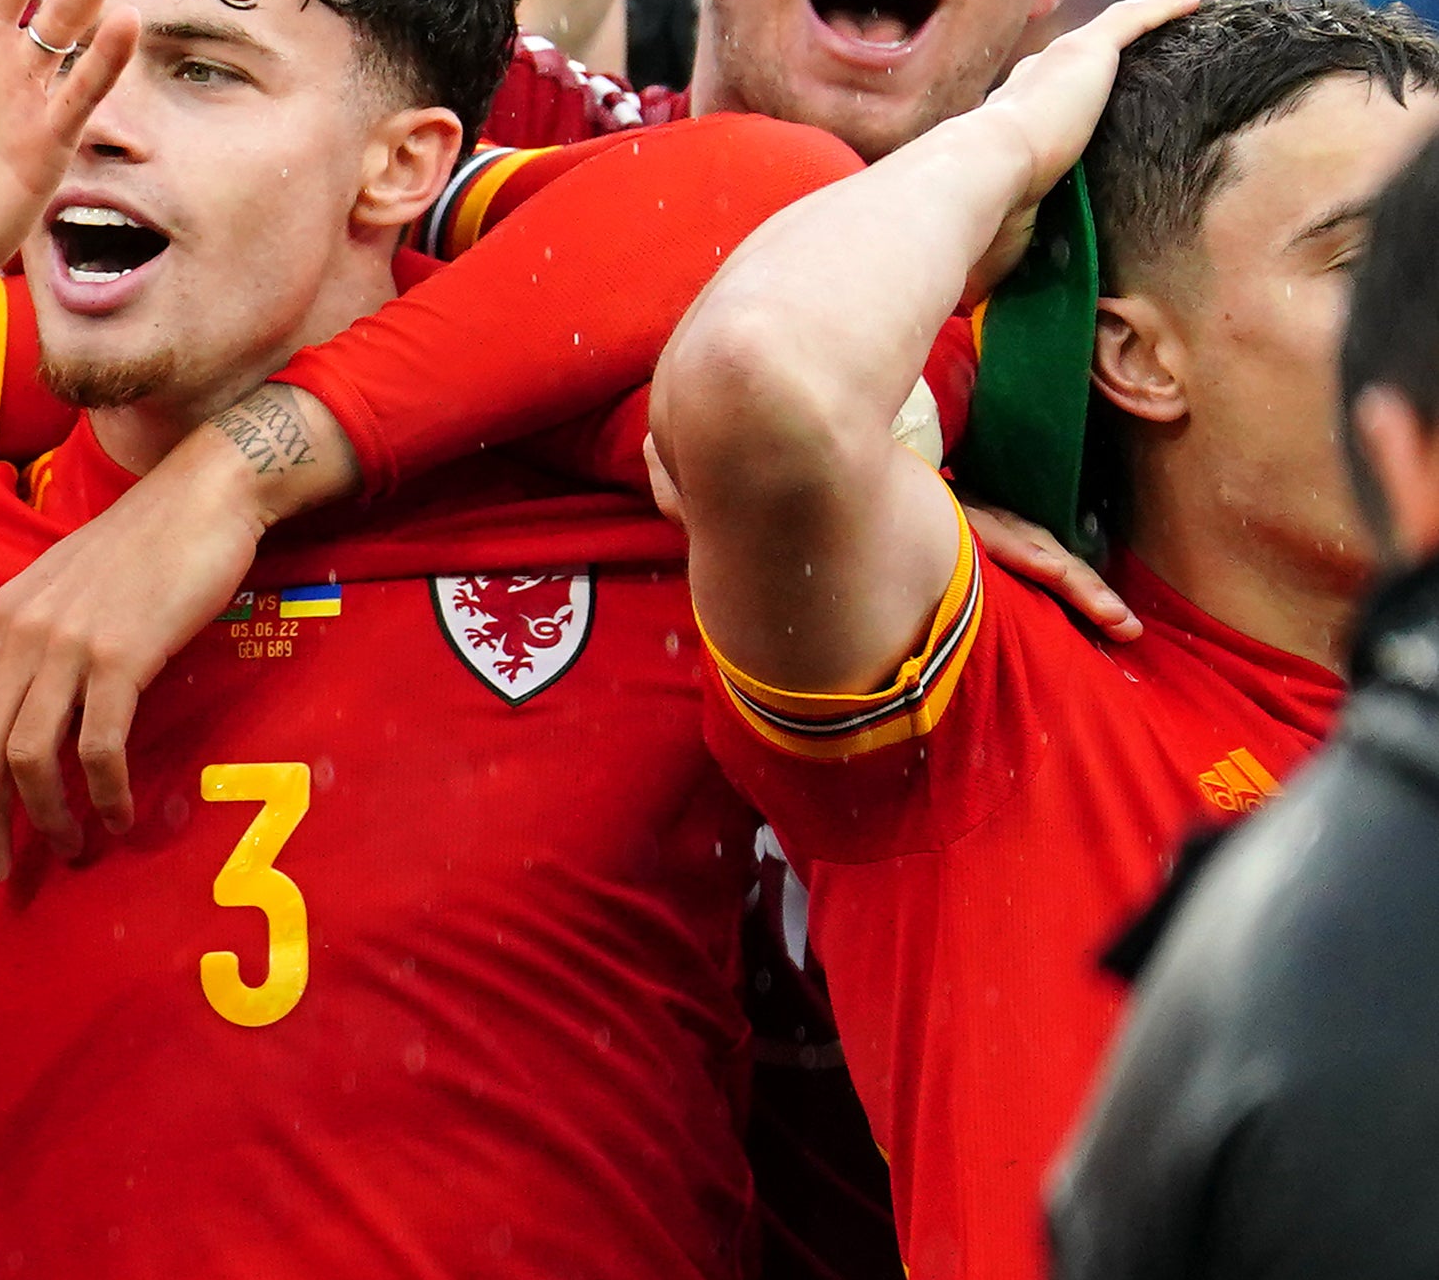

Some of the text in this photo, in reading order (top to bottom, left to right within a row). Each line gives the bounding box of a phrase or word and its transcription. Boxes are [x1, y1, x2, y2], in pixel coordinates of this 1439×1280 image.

[257, 594, 278, 612] VS
[230, 621, 300, 638] 05.06.22
[267, 640, 293, 658] 689
[200, 762, 311, 1027] 3
